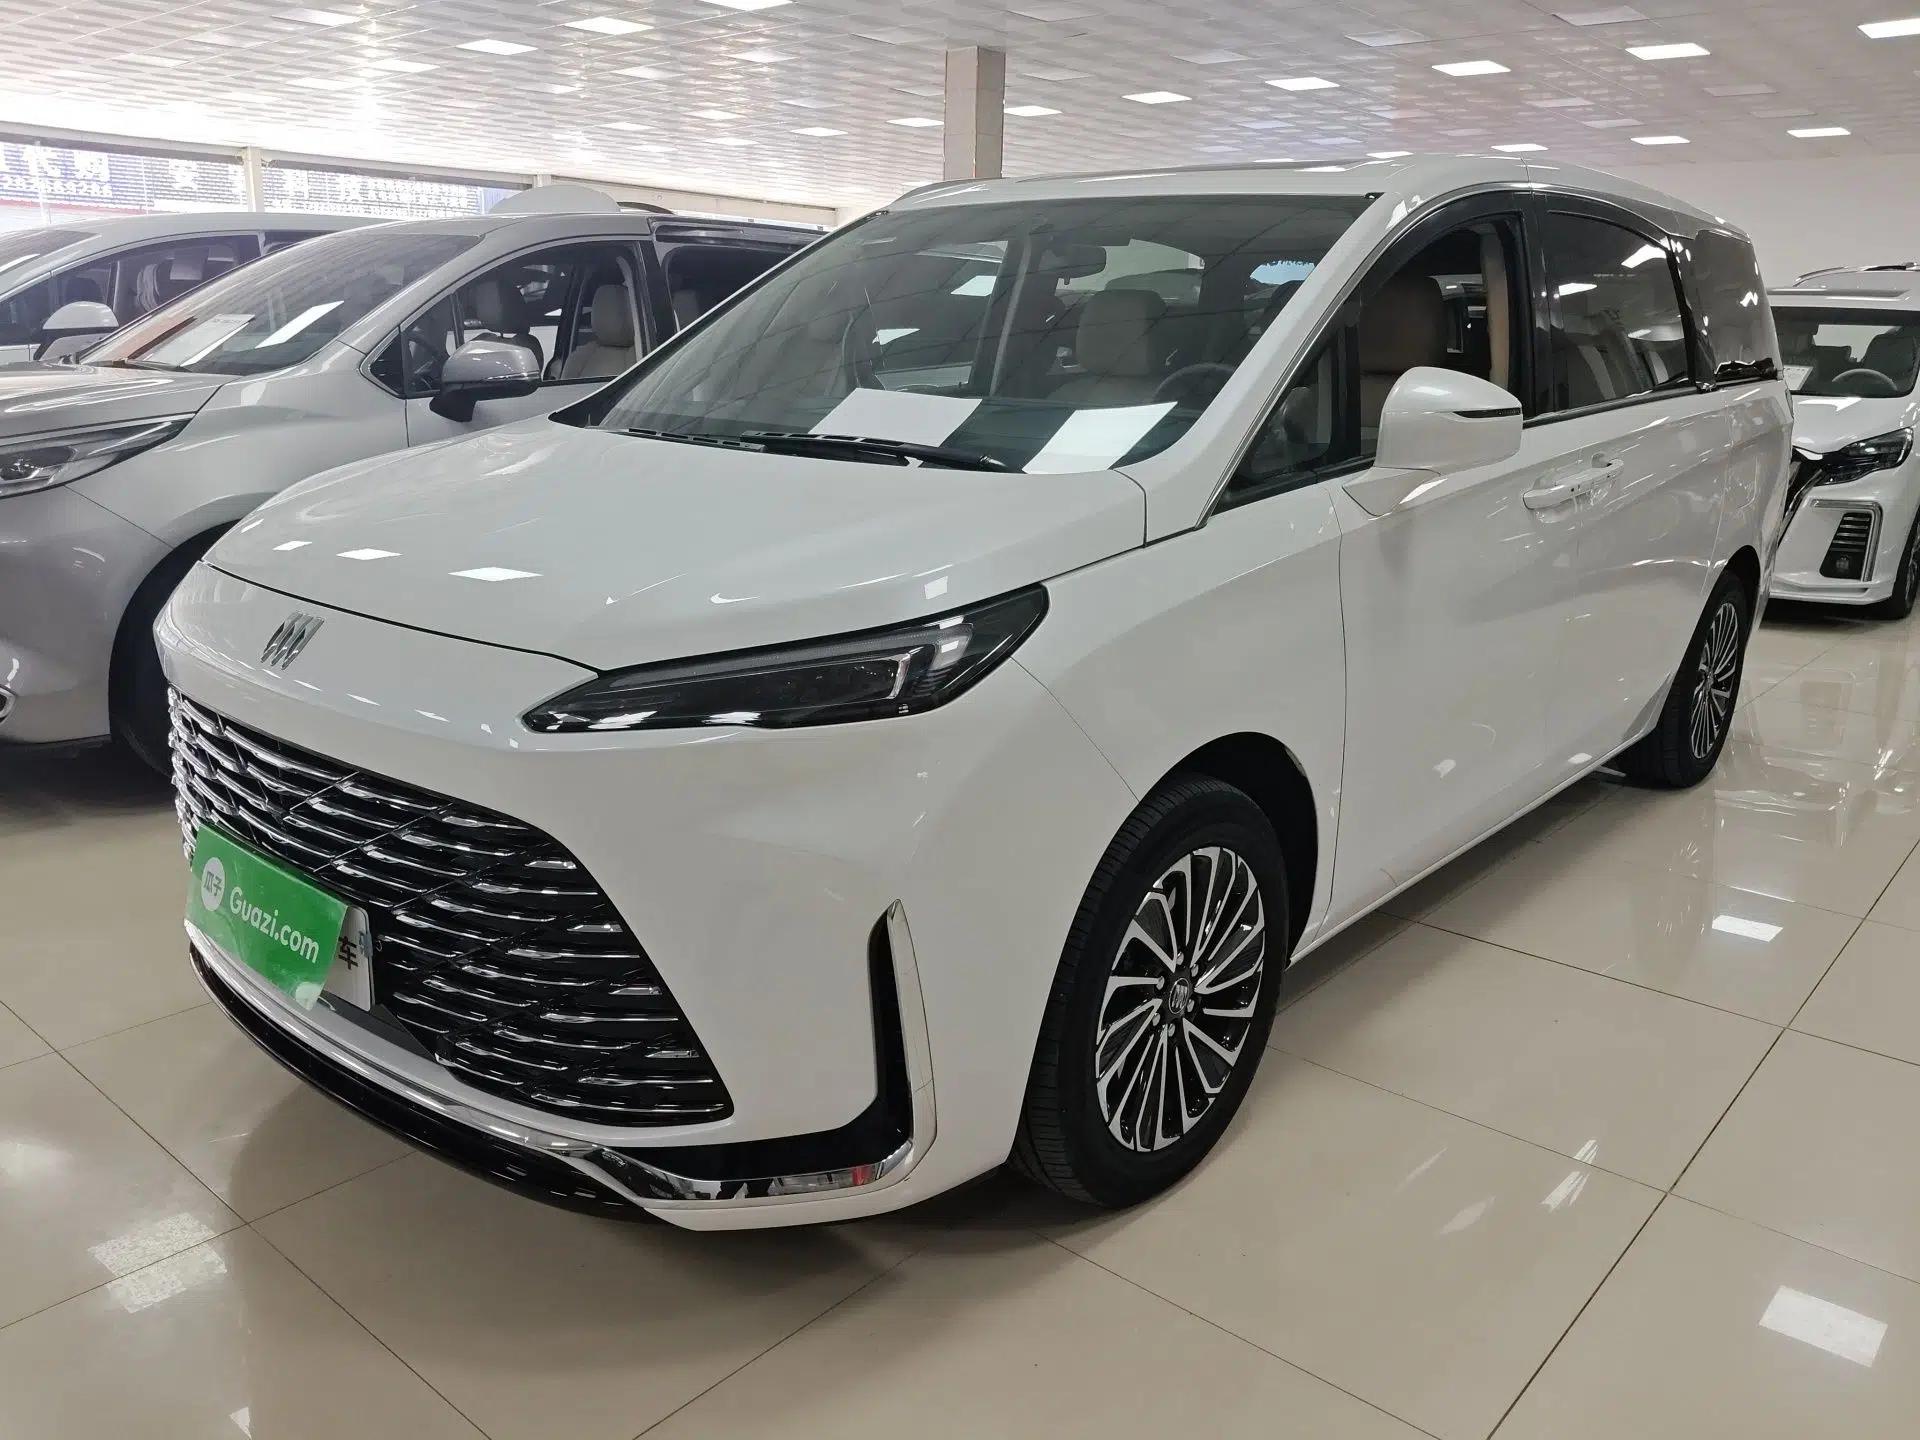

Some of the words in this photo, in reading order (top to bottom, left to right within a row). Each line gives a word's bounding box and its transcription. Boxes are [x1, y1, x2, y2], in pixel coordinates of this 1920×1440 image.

[203, 872, 222, 896] 瓜子
[230, 887, 319, 963] Guazi.com
[338, 936, 358, 970] 车
